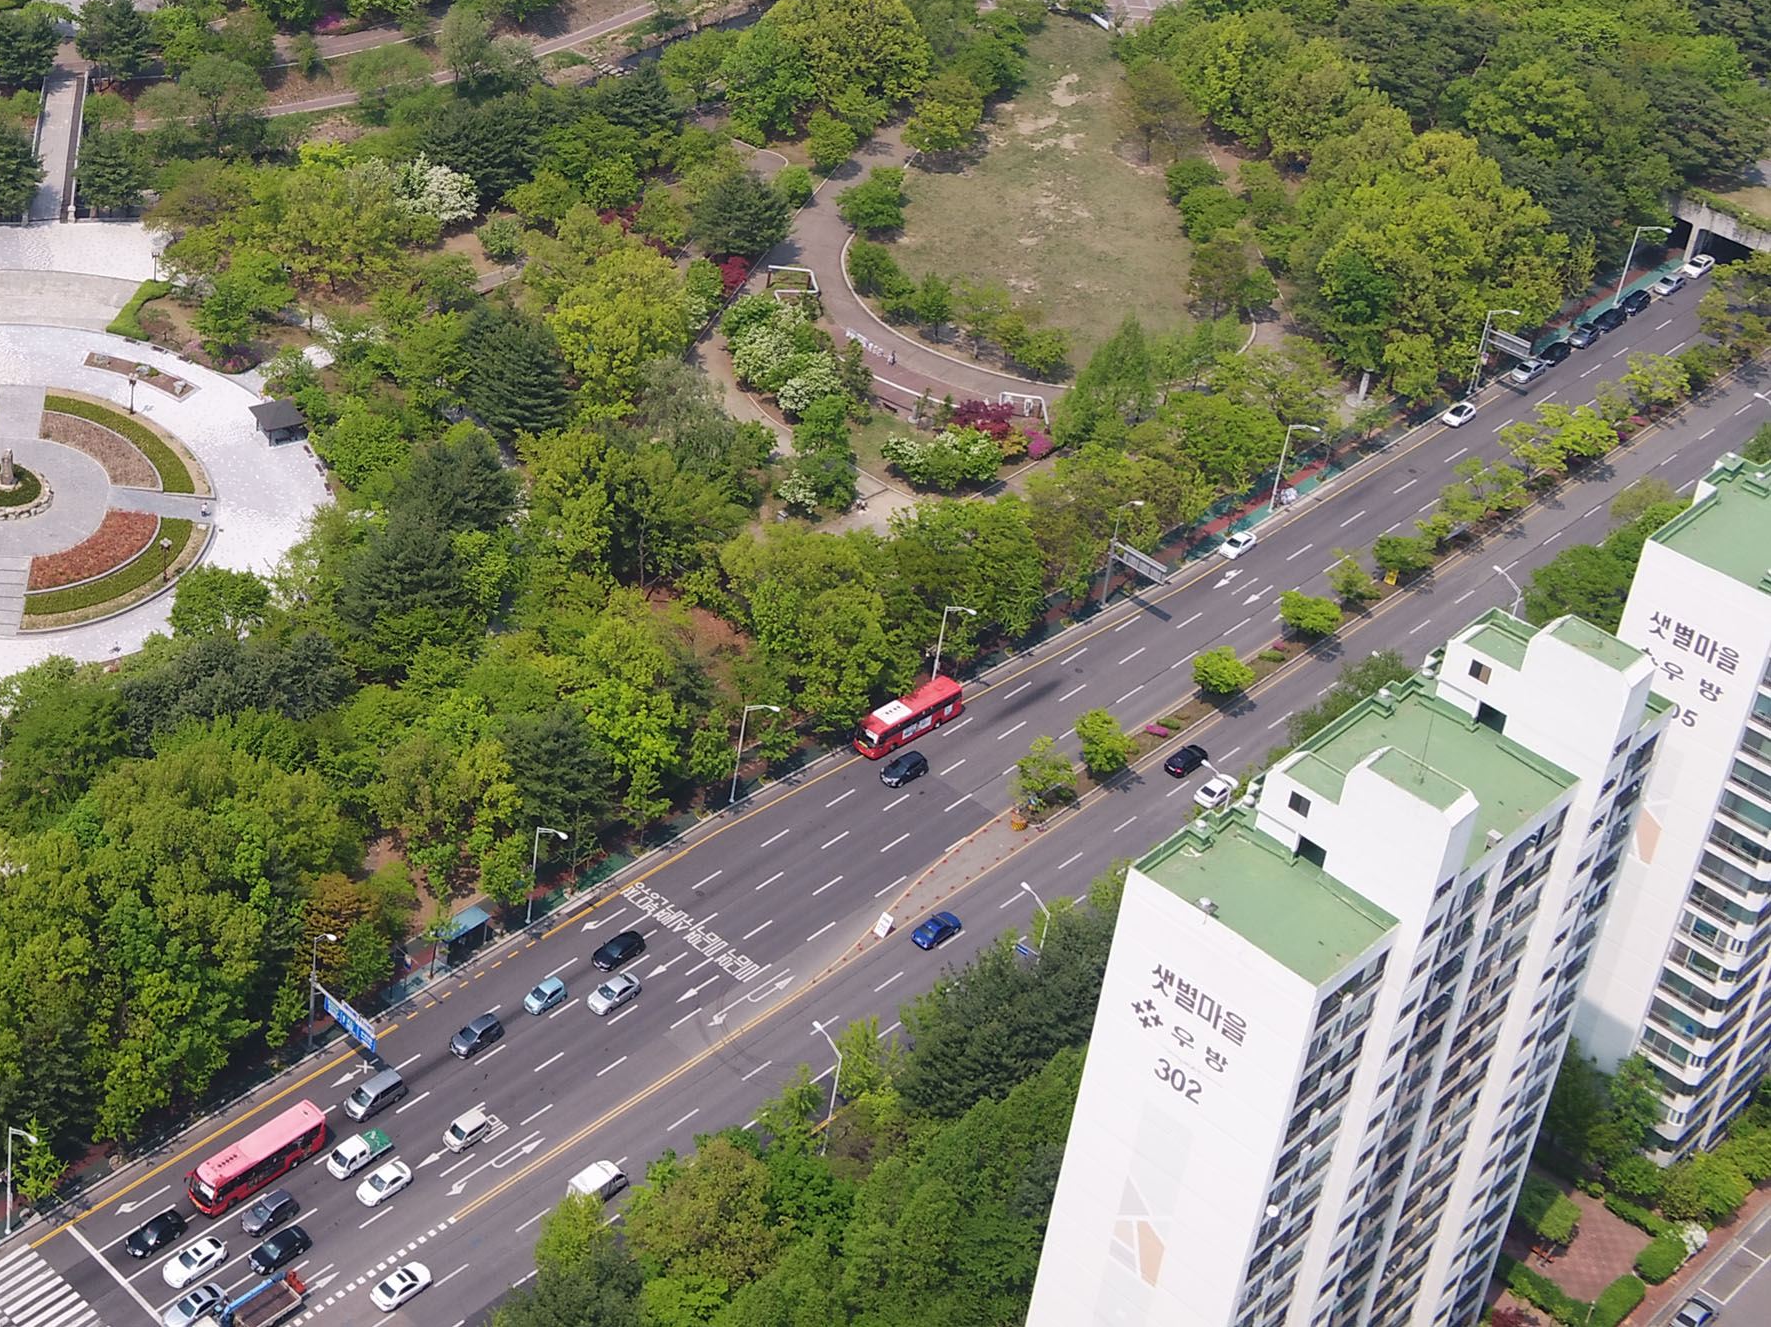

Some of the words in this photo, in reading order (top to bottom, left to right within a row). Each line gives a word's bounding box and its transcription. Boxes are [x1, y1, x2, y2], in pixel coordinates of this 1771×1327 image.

[1648, 611, 1740, 676] 샛별마을
[1152, 963, 1248, 1047] 샛별마을
[1154, 1058, 1203, 1105] 302
